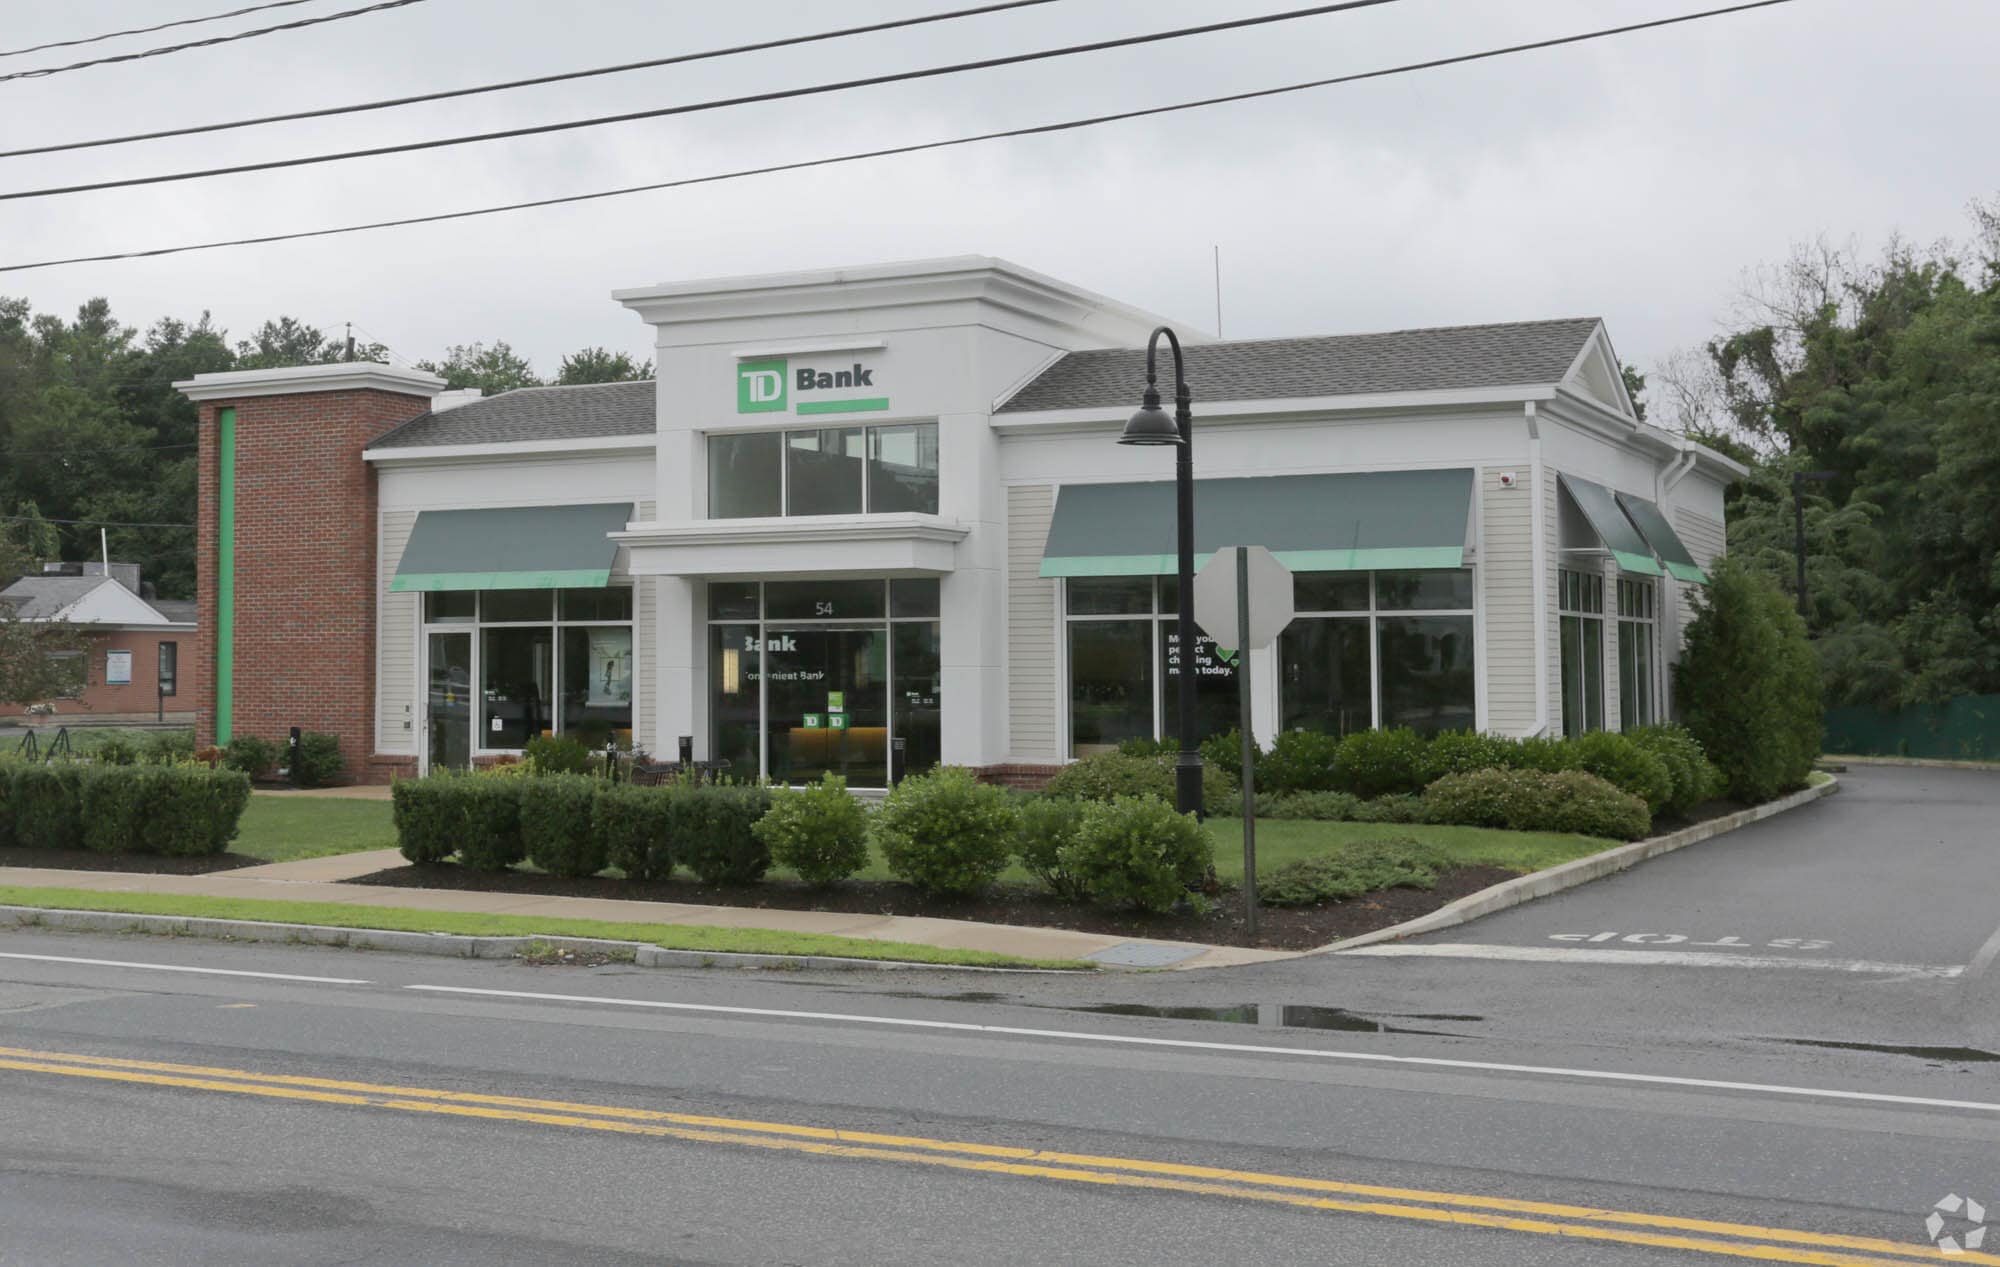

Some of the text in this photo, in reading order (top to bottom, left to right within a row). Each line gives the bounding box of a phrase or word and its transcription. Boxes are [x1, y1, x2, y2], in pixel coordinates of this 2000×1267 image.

[742, 364, 873, 402] TD Bank
[815, 602, 832, 615] 54
[1196, 635, 1216, 645] you
[1168, 656, 1212, 666] ching
[1202, 666, 1232, 676] today.
[1548, 932, 1833, 950] STOP
